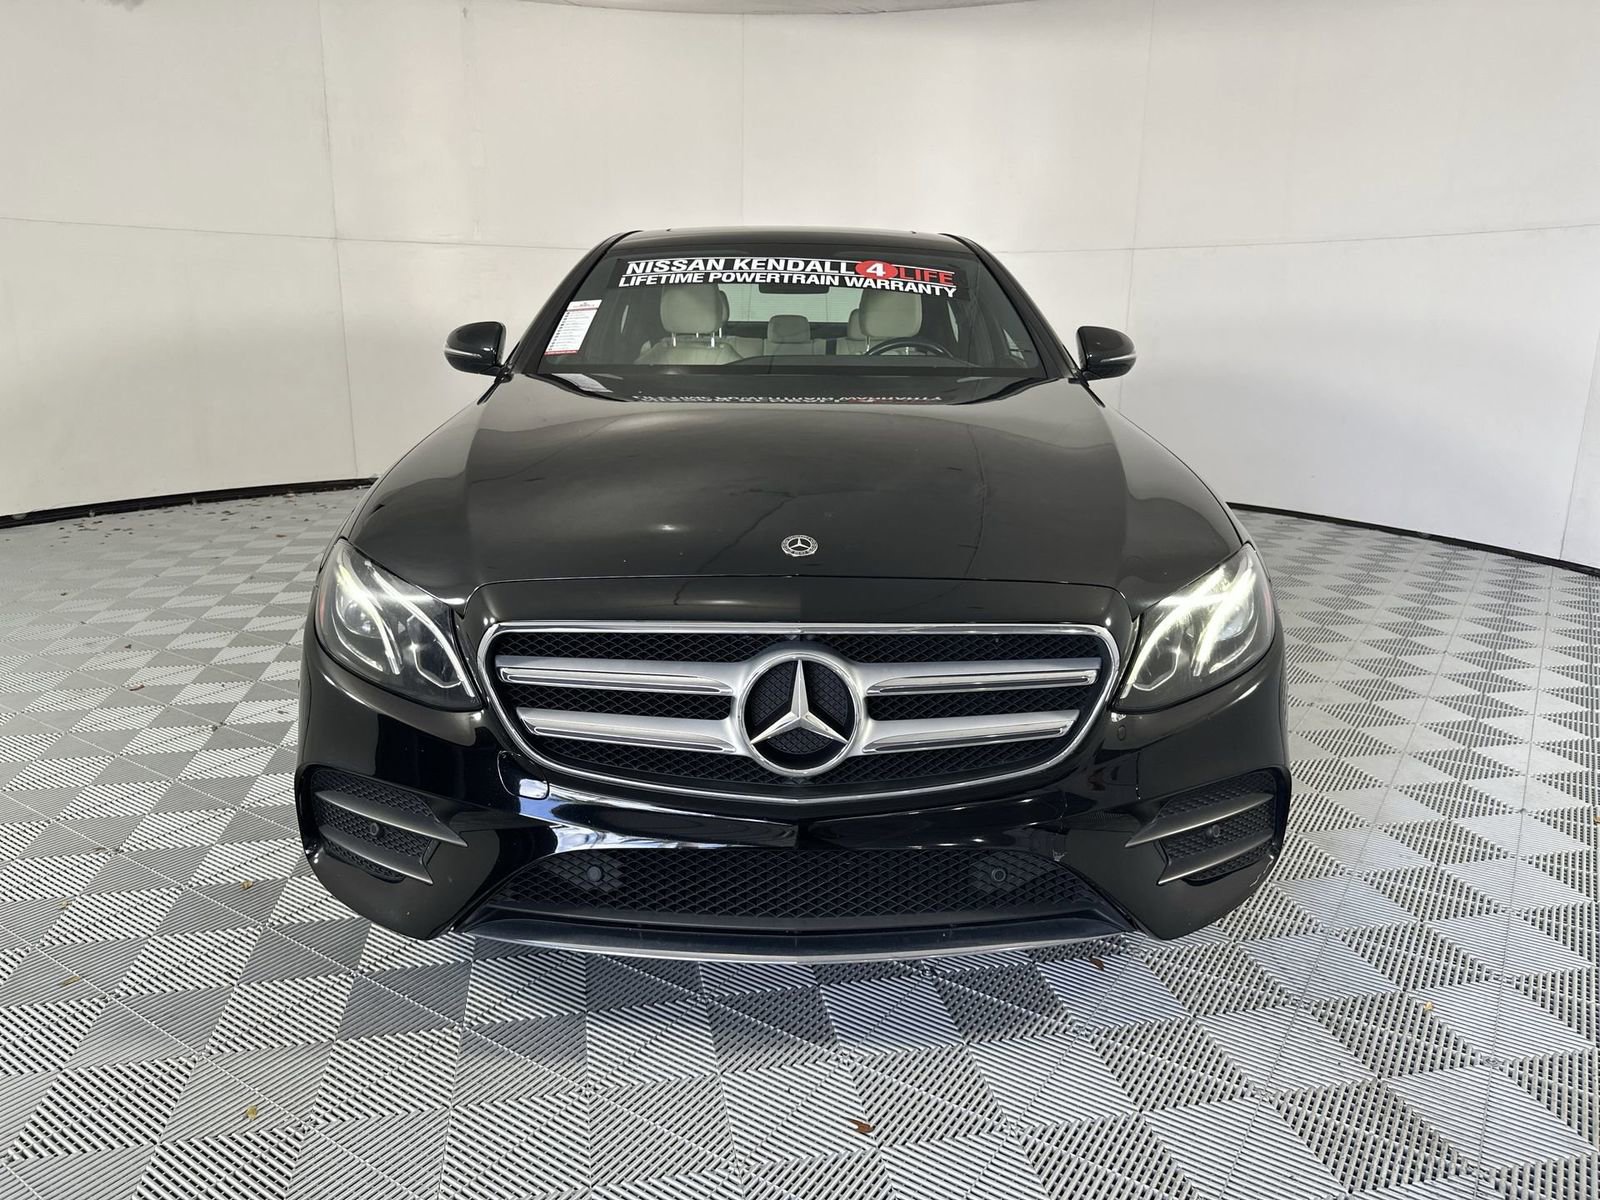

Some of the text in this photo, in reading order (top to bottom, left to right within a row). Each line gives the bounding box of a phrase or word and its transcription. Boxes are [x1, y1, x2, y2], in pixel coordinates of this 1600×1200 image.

[626, 259, 955, 285] NISSAN KENDALL 4 LIFE
[619, 273, 957, 298] LIFETIME POWERTRAIN WARRANTY
